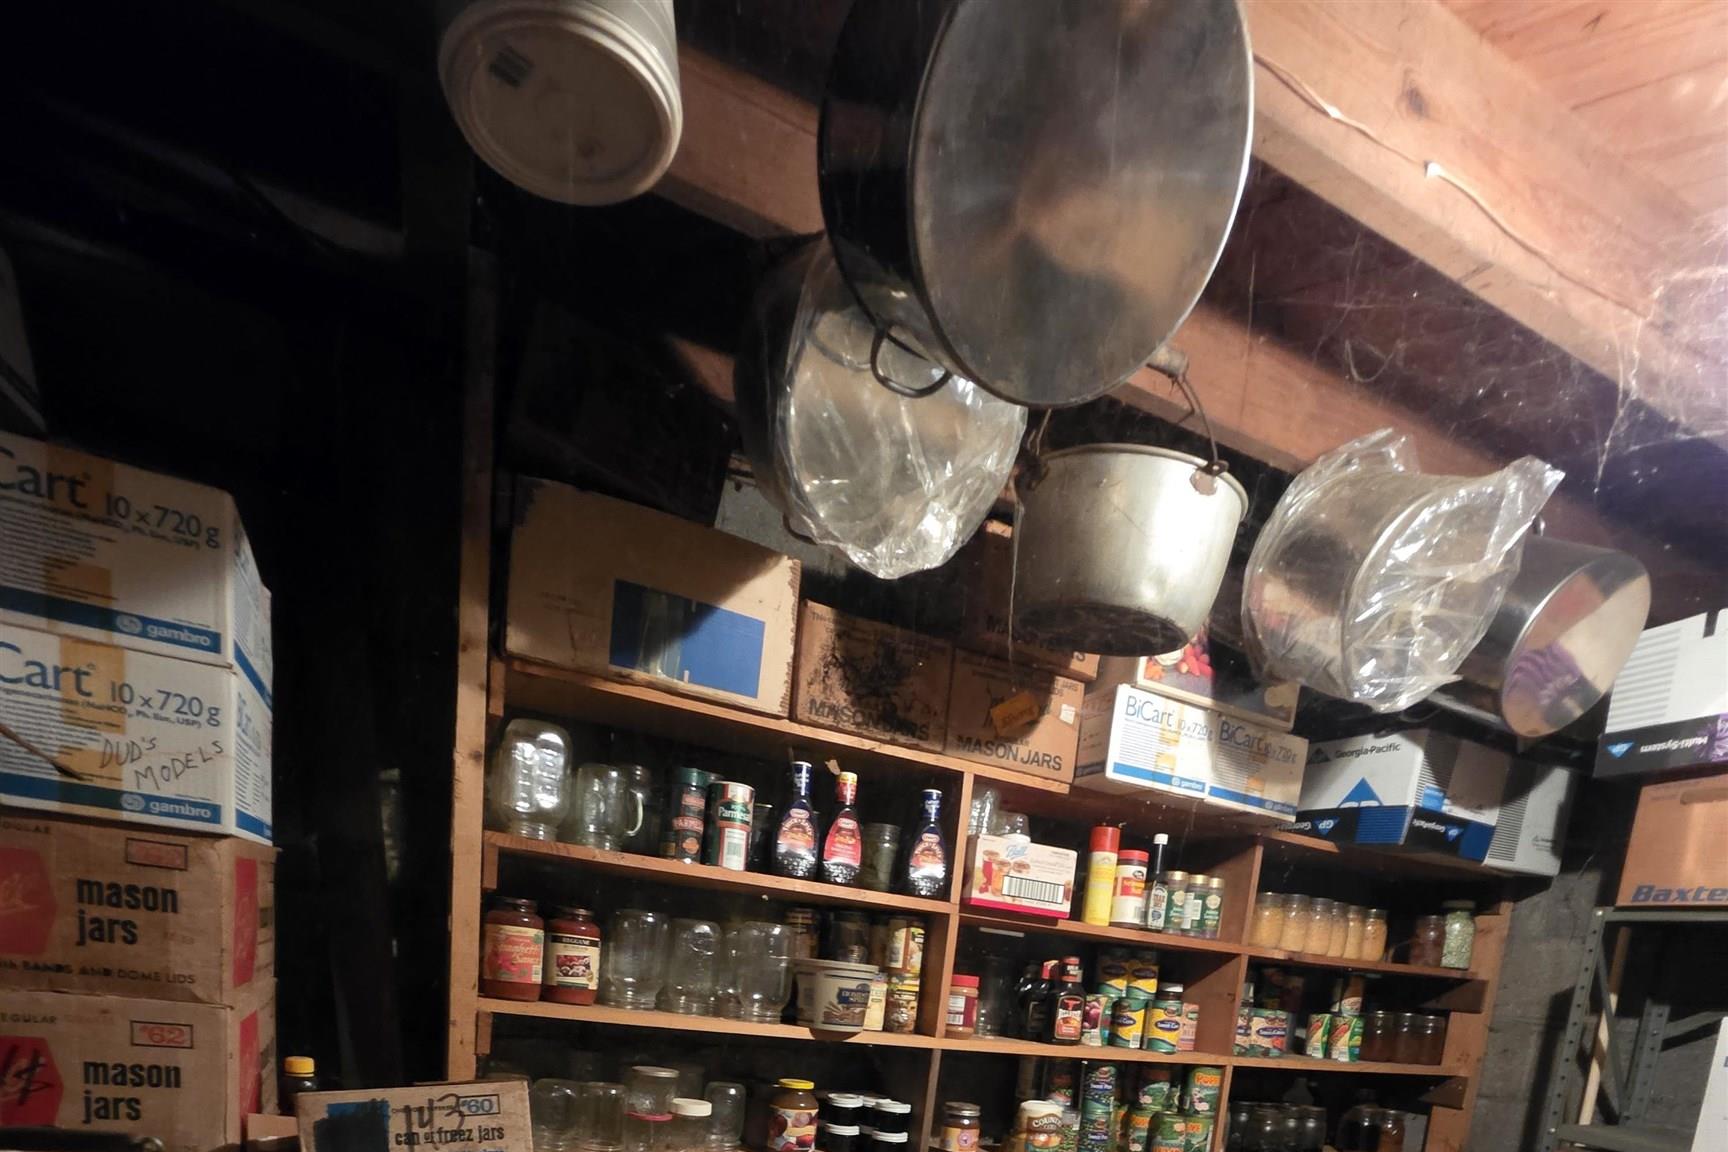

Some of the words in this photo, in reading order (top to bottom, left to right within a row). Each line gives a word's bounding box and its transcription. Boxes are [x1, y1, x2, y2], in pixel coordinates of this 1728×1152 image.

[105, 493, 130, 519] 10
[153, 504, 202, 538] 720
[146, 624, 211, 646] gambro
[111, 680, 134, 705] 10
[157, 689, 203, 717] 720
[1125, 695, 1173, 727] BiCart
[134, 740, 224, 791] MODELS
[957, 735, 1019, 763] MASON
[1020, 752, 1063, 772] JARS
[149, 801, 211, 819] gambro
[77, 878, 179, 914] mason
[1631, 884, 1728, 903] Baxte
[76, 908, 139, 946] jars
[118, 969, 161, 982] DOME
[167, 974, 197, 984] LIDS
[83, 1060, 182, 1089] mason
[83, 1090, 142, 1124] jars
[395, 1131, 421, 1146] can
[437, 1126, 474, 1143] freez
[477, 1124, 505, 1144] jars
